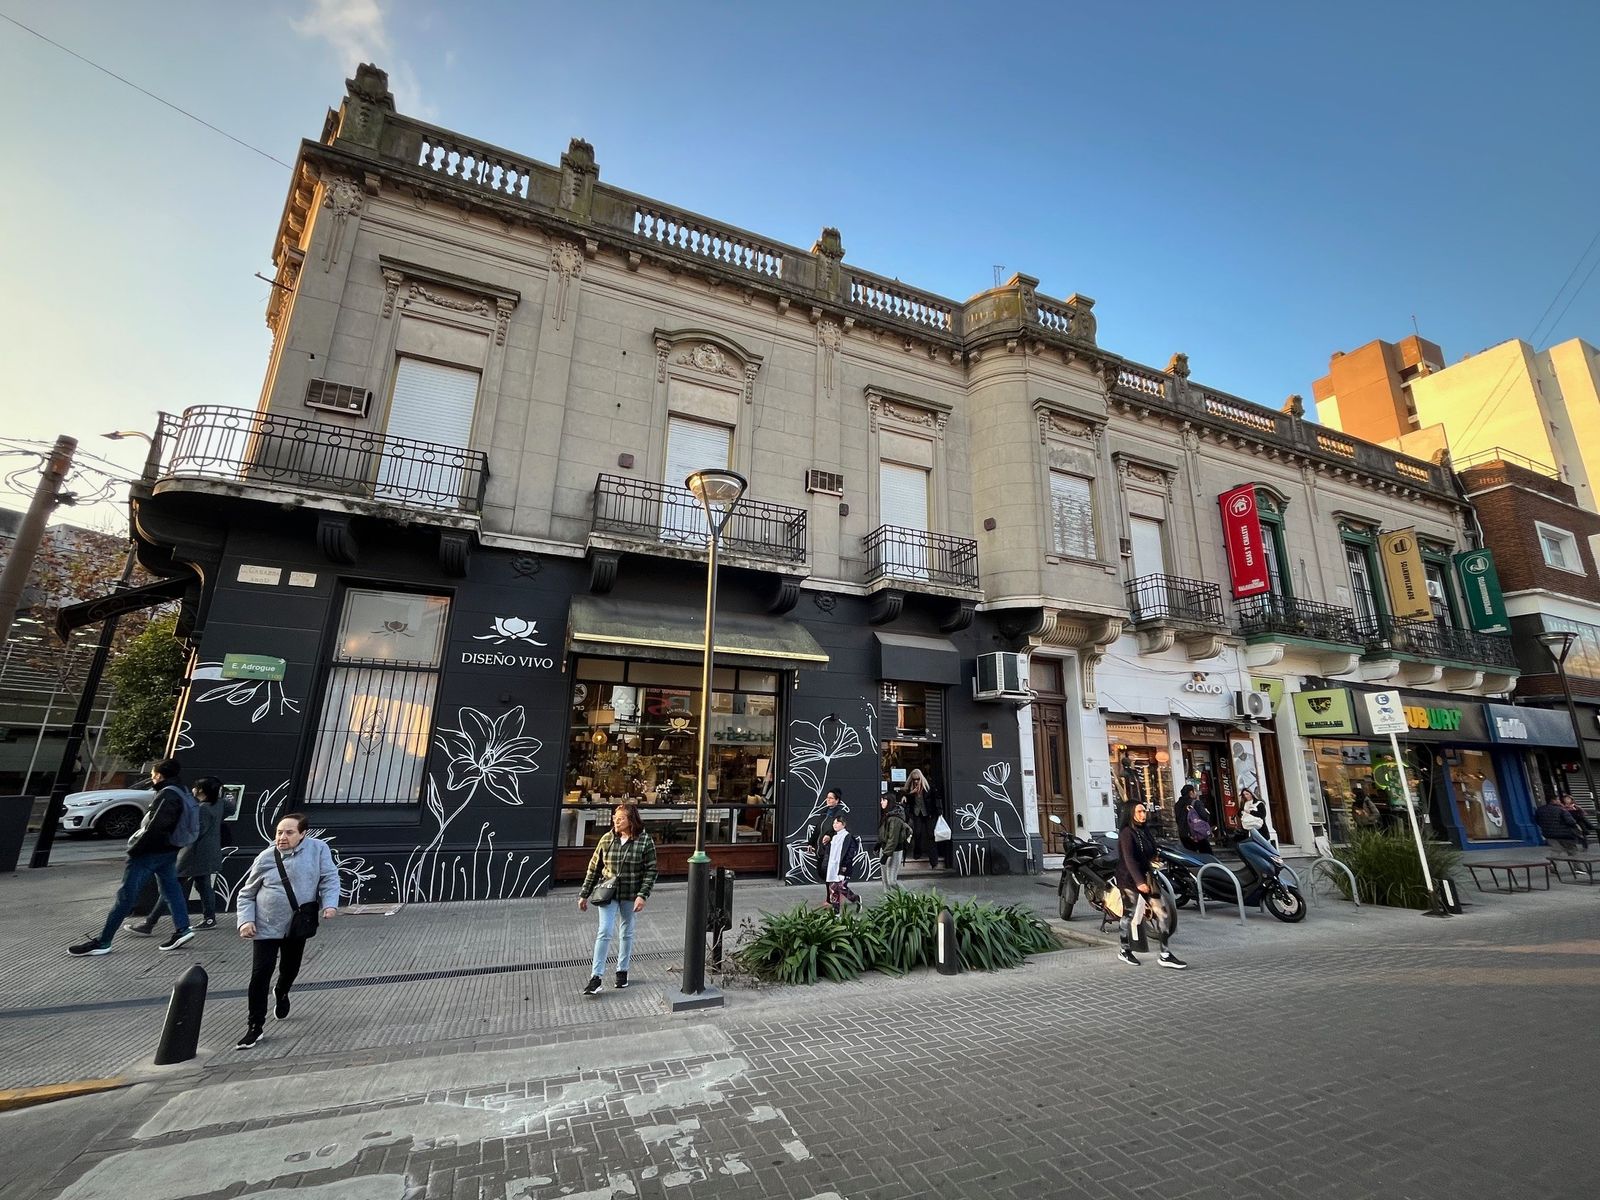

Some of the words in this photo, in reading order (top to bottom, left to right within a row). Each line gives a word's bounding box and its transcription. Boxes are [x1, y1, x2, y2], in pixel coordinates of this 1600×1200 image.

[1245, 551, 1254, 566] CASAS
[1400, 561, 1415, 600] DEPARTAMENTOS
[461, 651, 516, 666] DISEÑO
[519, 656, 554, 669] VIVO
[1220, 757, 1231, 796] BRAFRD
